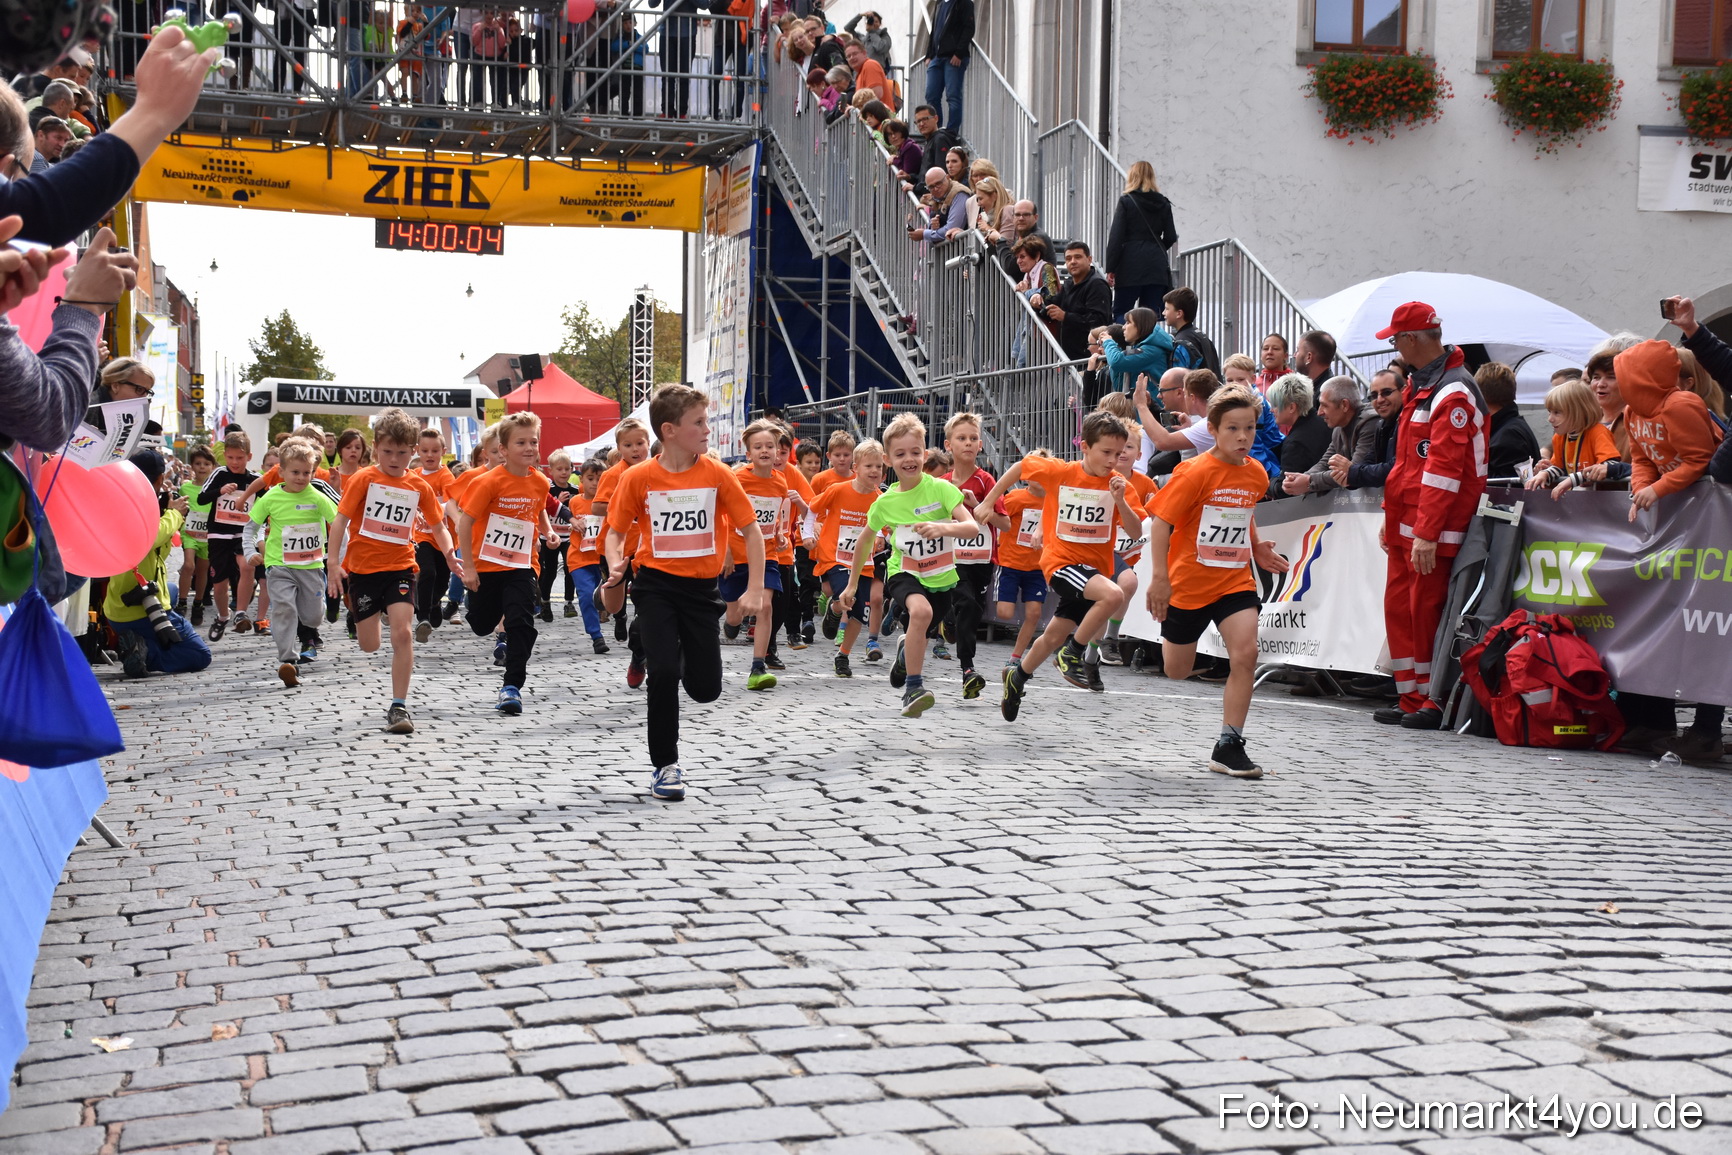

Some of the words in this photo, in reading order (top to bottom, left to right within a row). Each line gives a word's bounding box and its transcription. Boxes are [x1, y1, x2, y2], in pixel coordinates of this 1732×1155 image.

[162, 167, 234, 184] Neumarkter
[236, 174, 291, 190] Stadtlauf
[364, 164, 490, 210] ZIEL
[559, 195, 625, 208] Neumarkter
[627, 197, 676, 208] Stadtlauf
[191, 374, 204, 427] HOTE
[294, 385, 340, 403] MINI
[344, 387, 454, 406] NEUMARKT.
[222, 499, 249, 513] 703
[373, 501, 411, 523] 7157
[1065, 503, 1105, 523] 7152
[191, 520, 208, 531] 708
[660, 509, 707, 532] 7250
[756, 510, 774, 523] 235
[381, 524, 399, 534] Lukas
[1070, 526, 1097, 534] Johannes
[288, 535, 320, 550] 7108
[493, 529, 525, 550] 7171
[904, 535, 944, 557] 7131
[1214, 549, 1237, 557] Samuel
